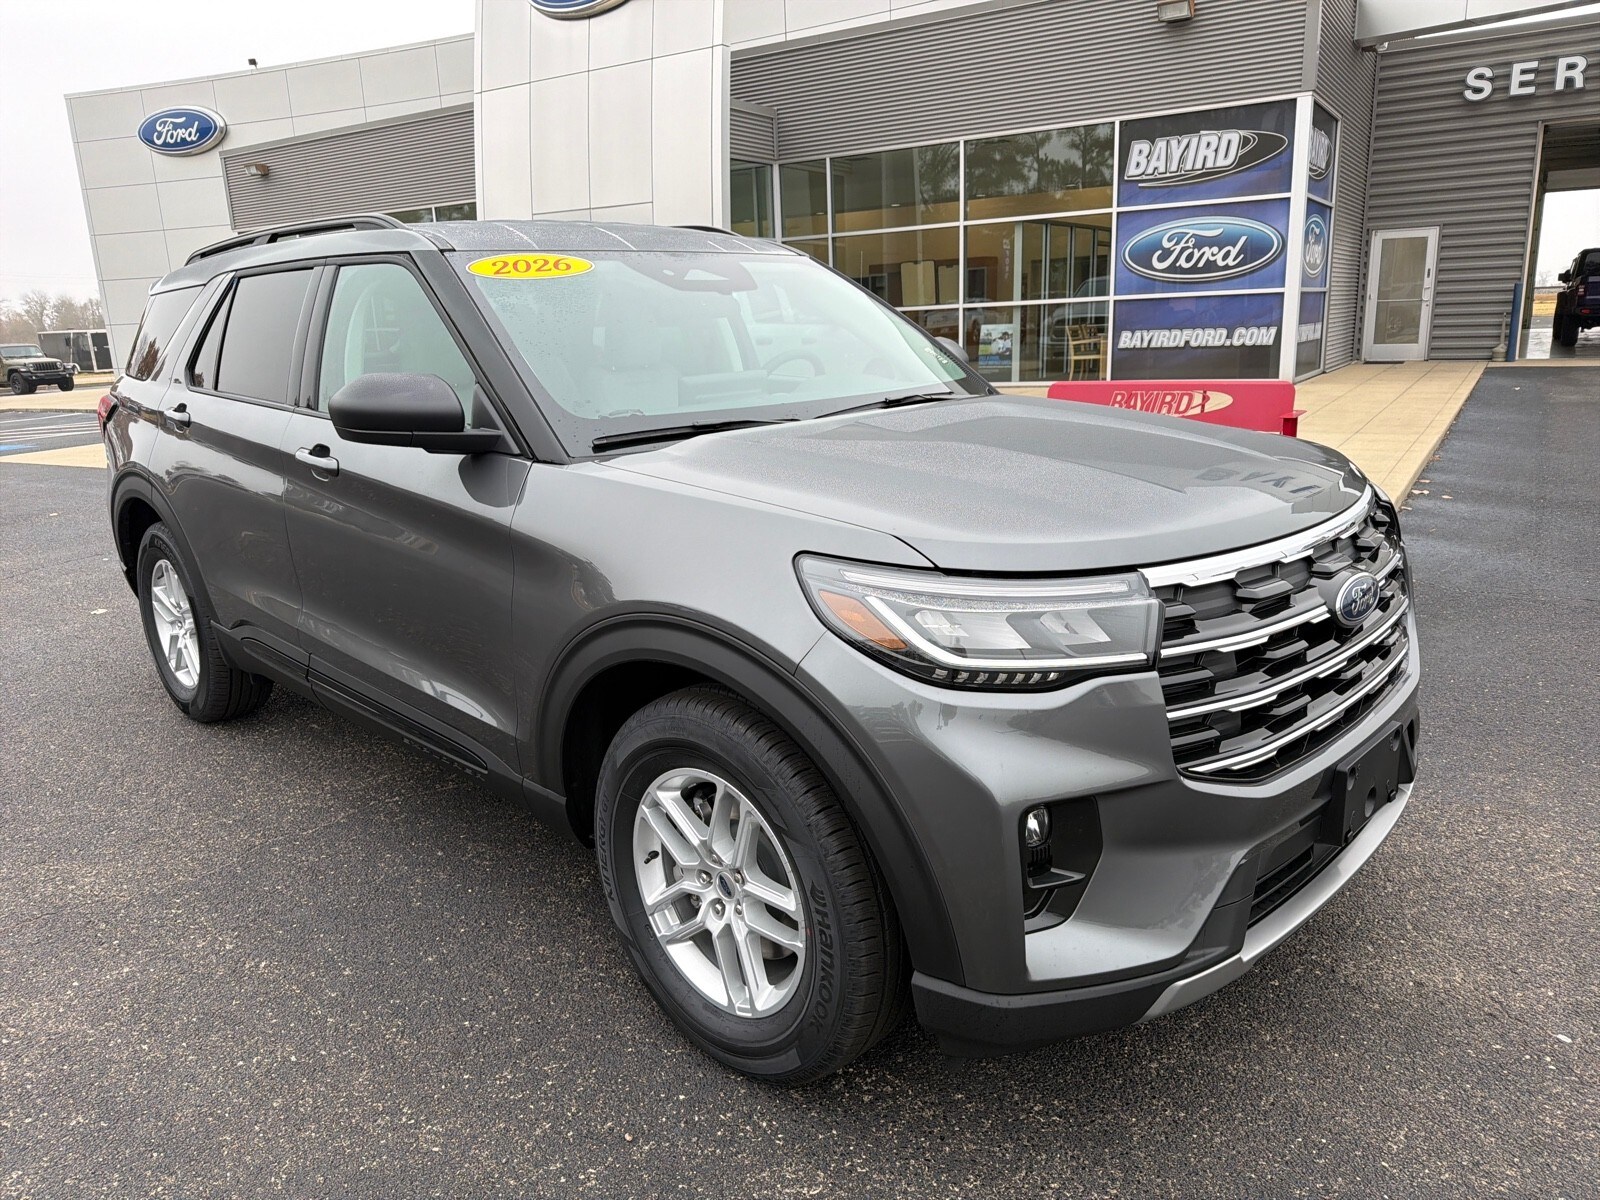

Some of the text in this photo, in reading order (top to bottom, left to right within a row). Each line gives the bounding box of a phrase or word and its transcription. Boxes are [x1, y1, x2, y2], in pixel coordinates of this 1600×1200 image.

[1463, 55, 1588, 102] SER
[153, 117, 199, 145] Ford
[1124, 129, 1243, 180] BAYIRD
[1152, 228, 1247, 269] Ford
[1306, 223, 1323, 265] Ford
[491, 257, 572, 275] 2026
[1118, 327, 1277, 348] BAYIRDFORD.COM
[1110, 390, 1195, 416] BAYIRD
[1351, 582, 1375, 616] Ford
